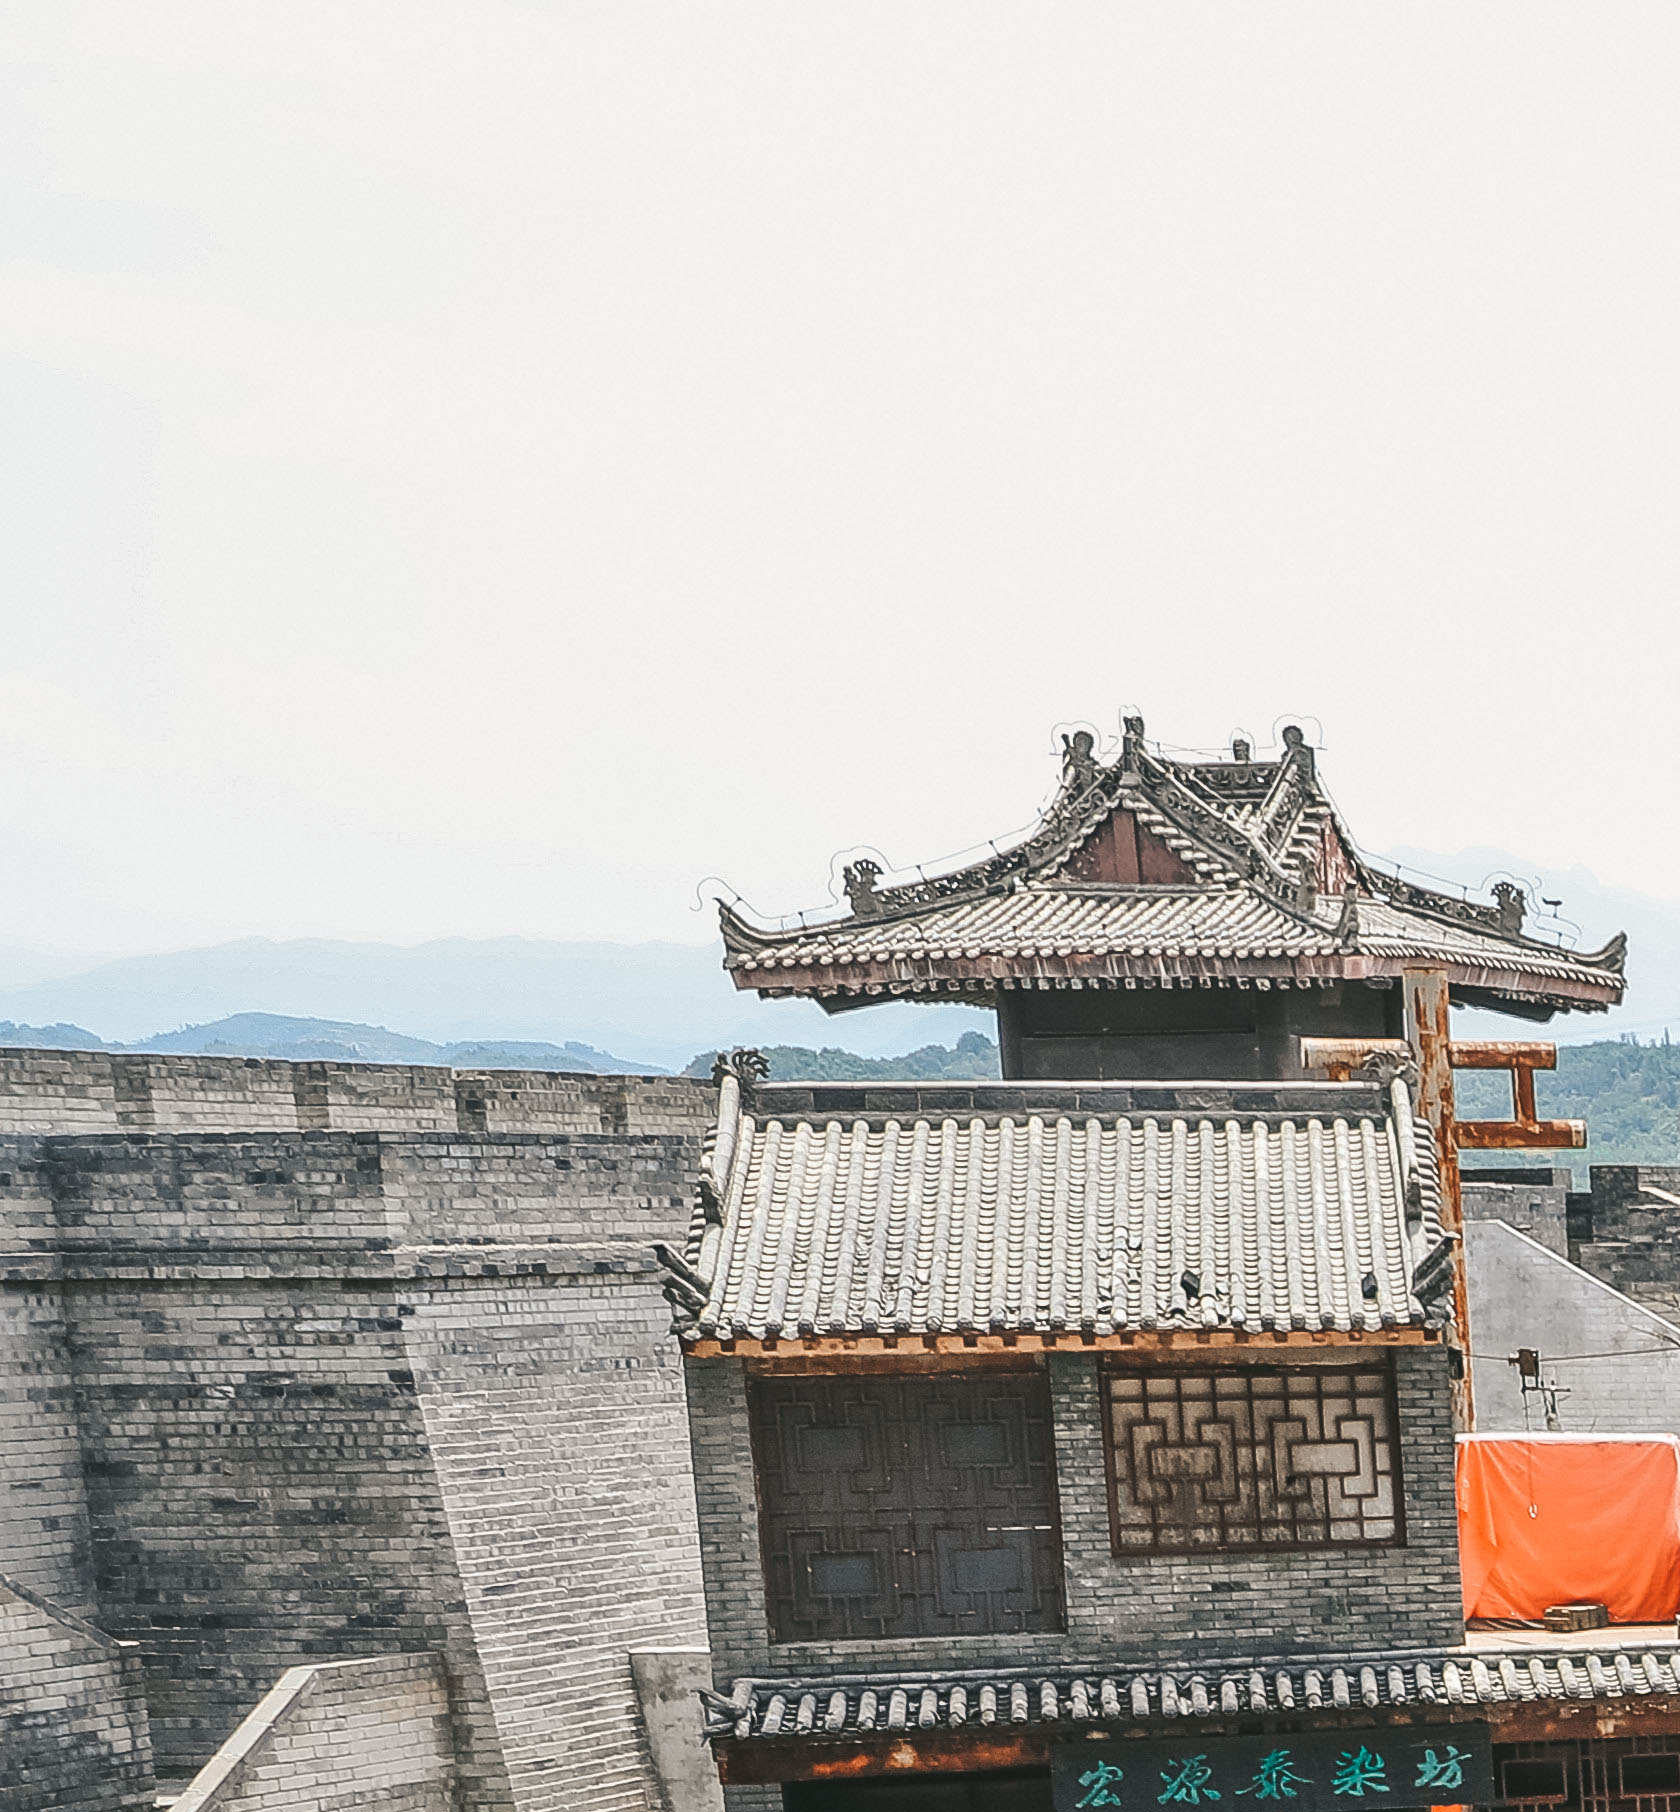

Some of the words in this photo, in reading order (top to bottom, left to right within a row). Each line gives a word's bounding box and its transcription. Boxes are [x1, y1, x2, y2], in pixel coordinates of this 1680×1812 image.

[1075, 1745, 1472, 1808] 宏源泰染坊
